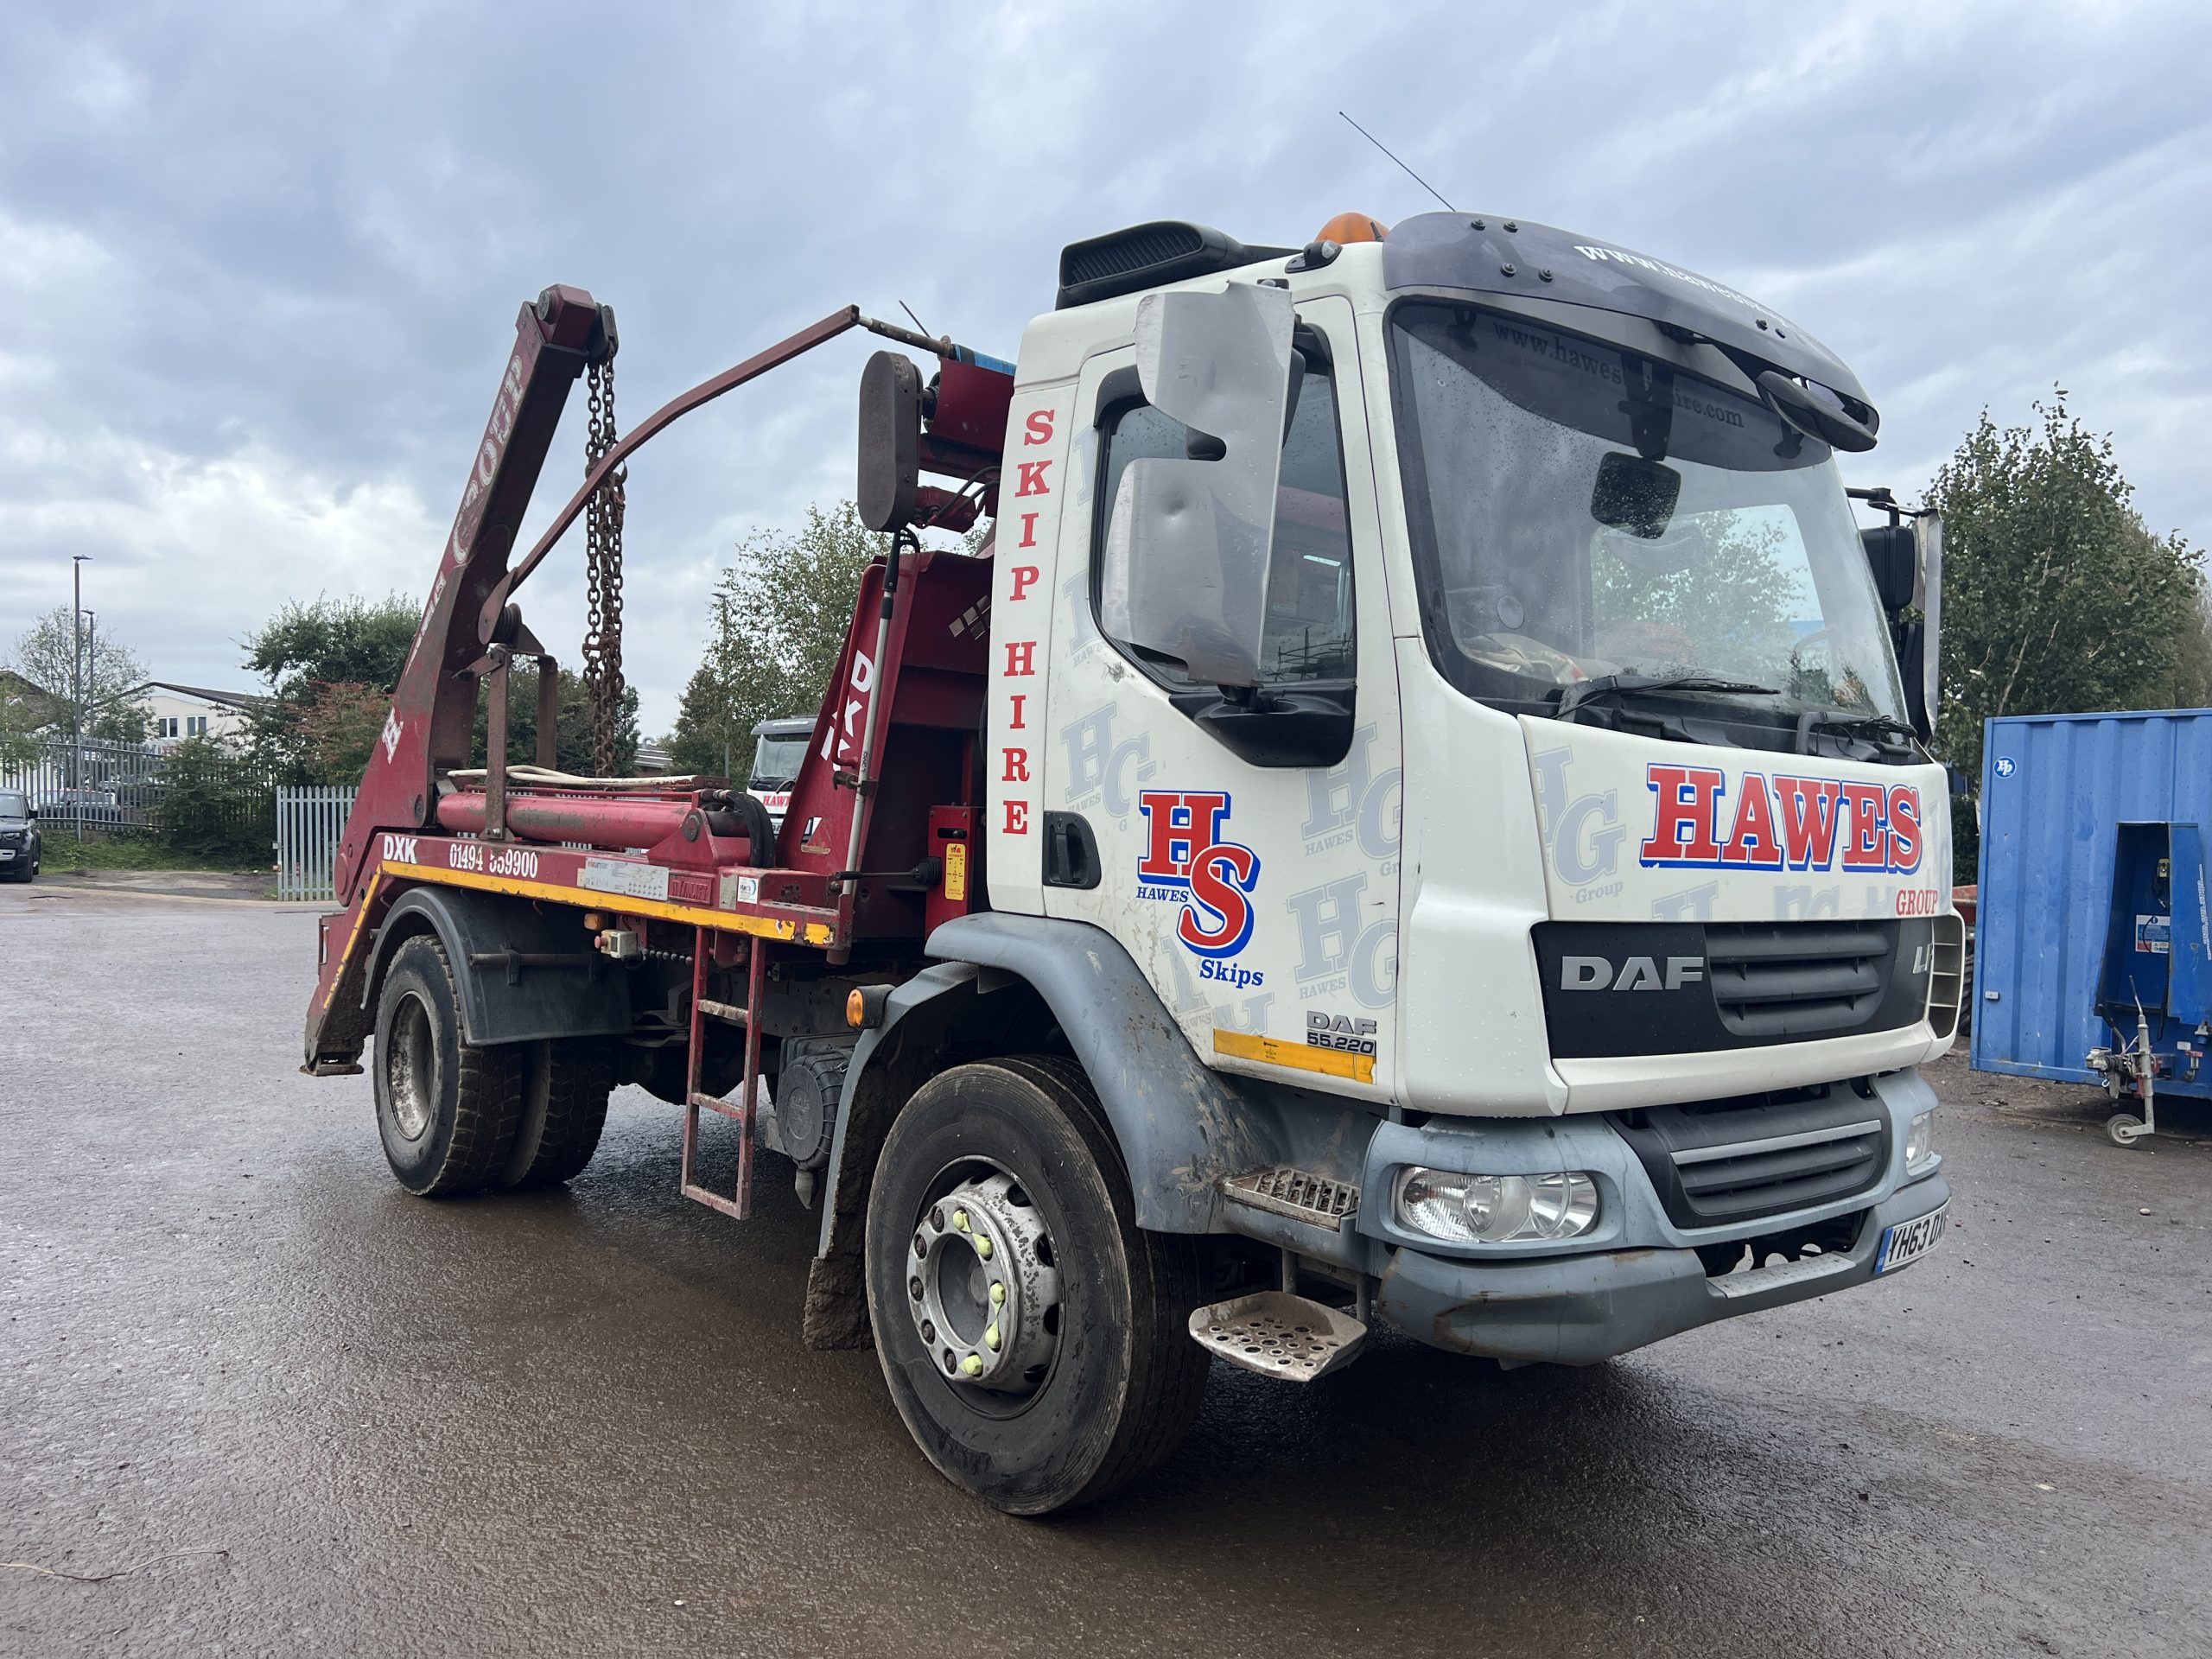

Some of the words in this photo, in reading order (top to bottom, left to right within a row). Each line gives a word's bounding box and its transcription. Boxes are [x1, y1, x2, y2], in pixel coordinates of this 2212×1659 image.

[1009, 409, 1055, 601] SKIP
[1001, 641, 1037, 835] HIRE
[1639, 762, 1923, 875] HAWES
[383, 835, 417, 864] DXK
[449, 842, 483, 871] 01494
[1305, 830, 1354, 856] HAWES
[1136, 886, 1189, 903] HAWES
[1575, 880, 1624, 904] Group
[1896, 889, 1938, 916] GROUP
[1199, 958, 1263, 988] Skips
[1560, 956, 1704, 991] DAF
[1300, 976, 1346, 1000] HAWES
[1306, 1010, 1377, 1036] DAF
[1307, 1032, 1375, 1054] 55.220
[1889, 1218, 1930, 1262] YH63
